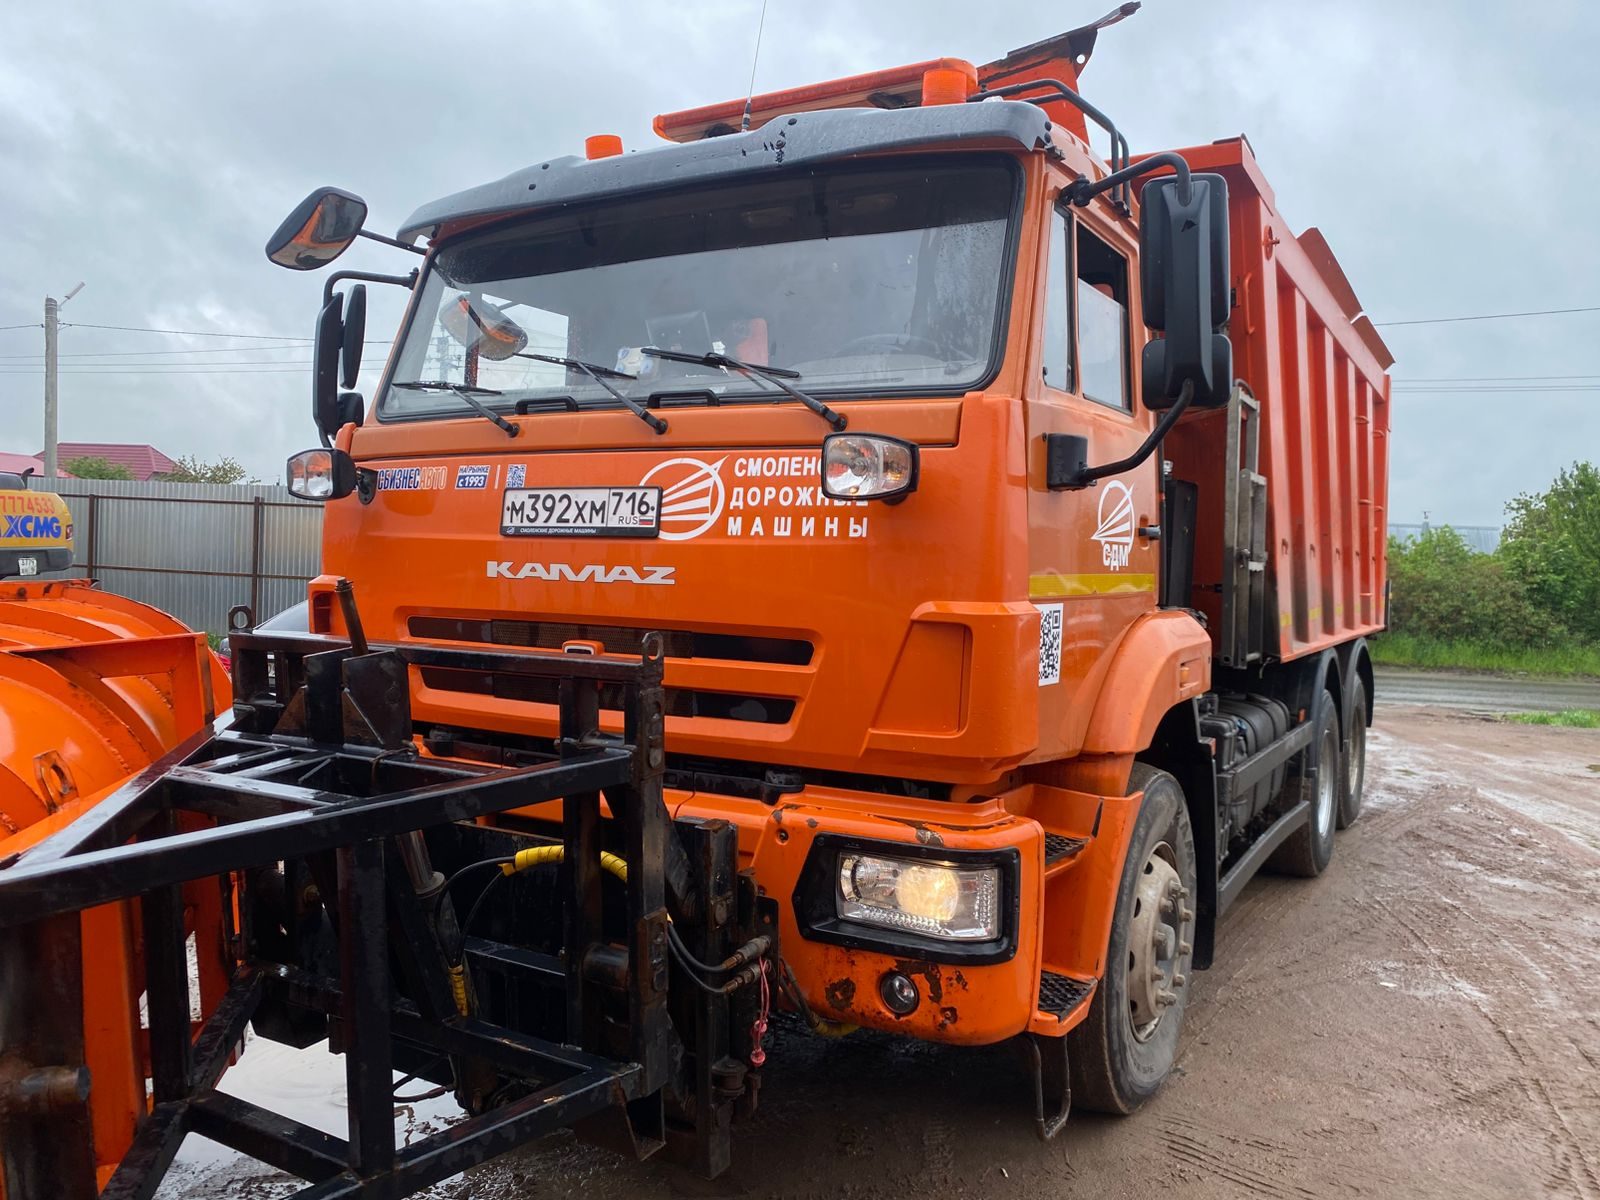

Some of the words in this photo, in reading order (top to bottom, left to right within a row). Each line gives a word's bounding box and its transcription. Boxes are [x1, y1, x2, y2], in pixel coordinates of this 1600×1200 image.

[378, 466, 447, 489] СБИЗНЕСАВТО
[734, 457, 822, 477] СМОЛЕН
[465, 476, 485, 487] 1993
[509, 494, 606, 523] М392ХМ
[612, 492, 650, 516] 716
[3, 515, 62, 539] XCMG
[618, 516, 638, 524] RUS
[727, 516, 868, 537] МАШИНЫ
[1102, 544, 1129, 571] СДМ
[486, 560, 676, 585] KAMAZ
